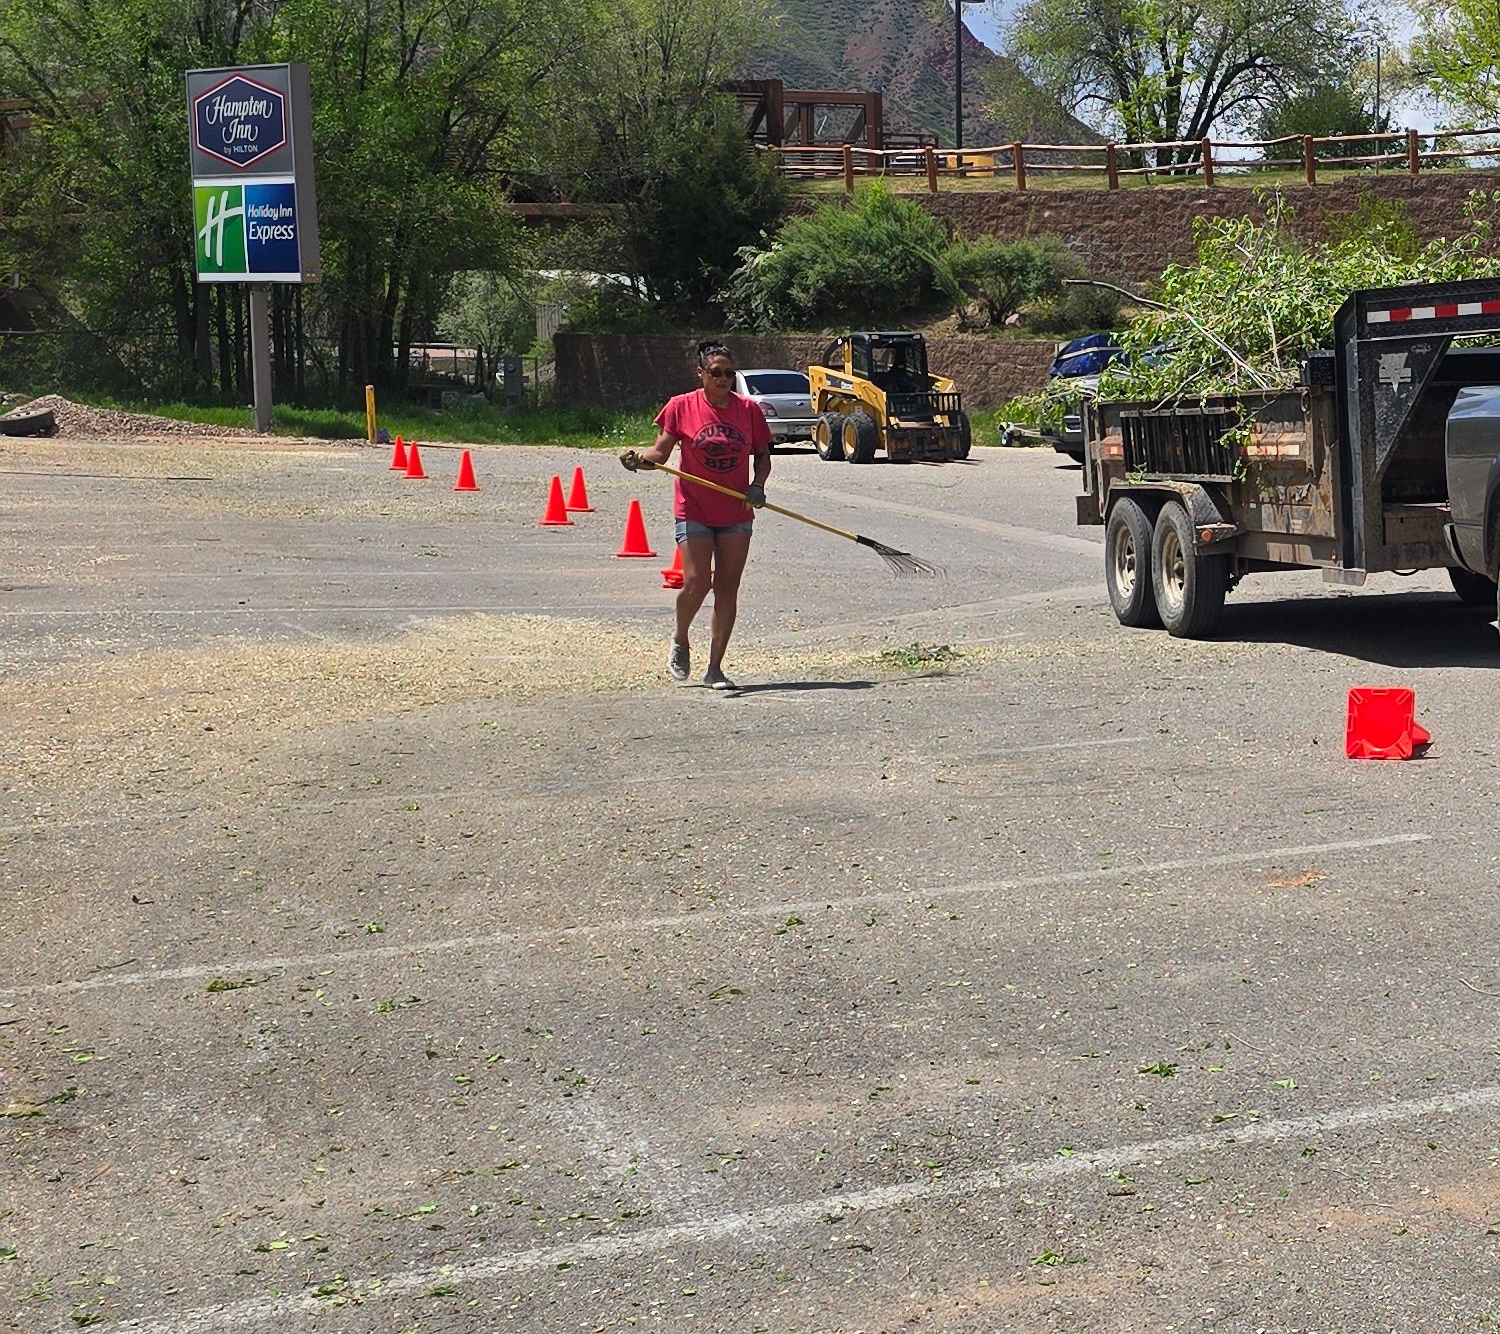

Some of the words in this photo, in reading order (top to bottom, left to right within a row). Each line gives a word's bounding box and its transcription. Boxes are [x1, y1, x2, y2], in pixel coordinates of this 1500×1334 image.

[205, 94, 273, 124] Hampton
[222, 118, 258, 143] Inn
[223, 146, 232, 155] by
[233, 144, 258, 153] HILTON
[248, 203, 279, 220] Holiday
[280, 203, 292, 217] Inn
[248, 221, 294, 244] Express
[693, 424, 746, 445] SUPER
[704, 456, 738, 469] BEE
